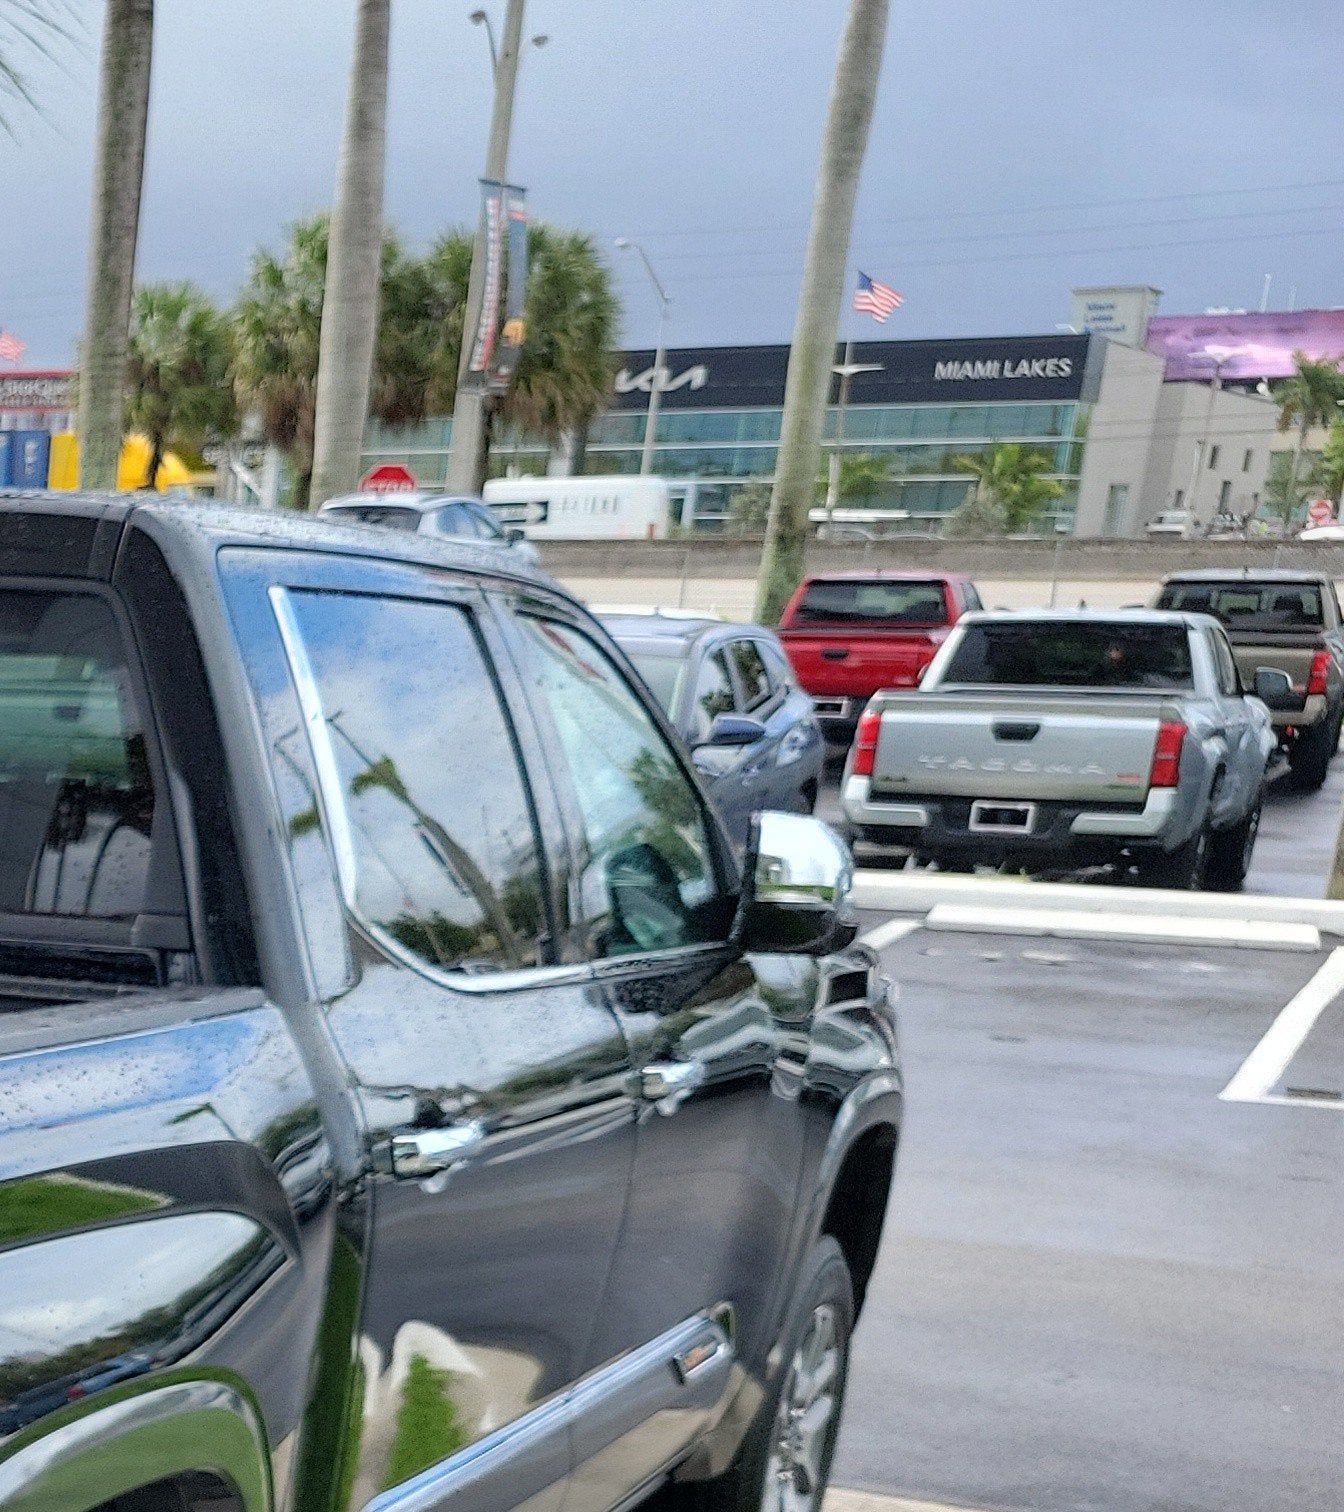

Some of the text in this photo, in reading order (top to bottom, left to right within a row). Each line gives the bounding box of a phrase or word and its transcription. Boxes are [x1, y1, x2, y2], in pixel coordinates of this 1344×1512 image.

[934, 357, 1073, 380] MIAMI LAKES
[917, 755, 1106, 775] TACOMA
